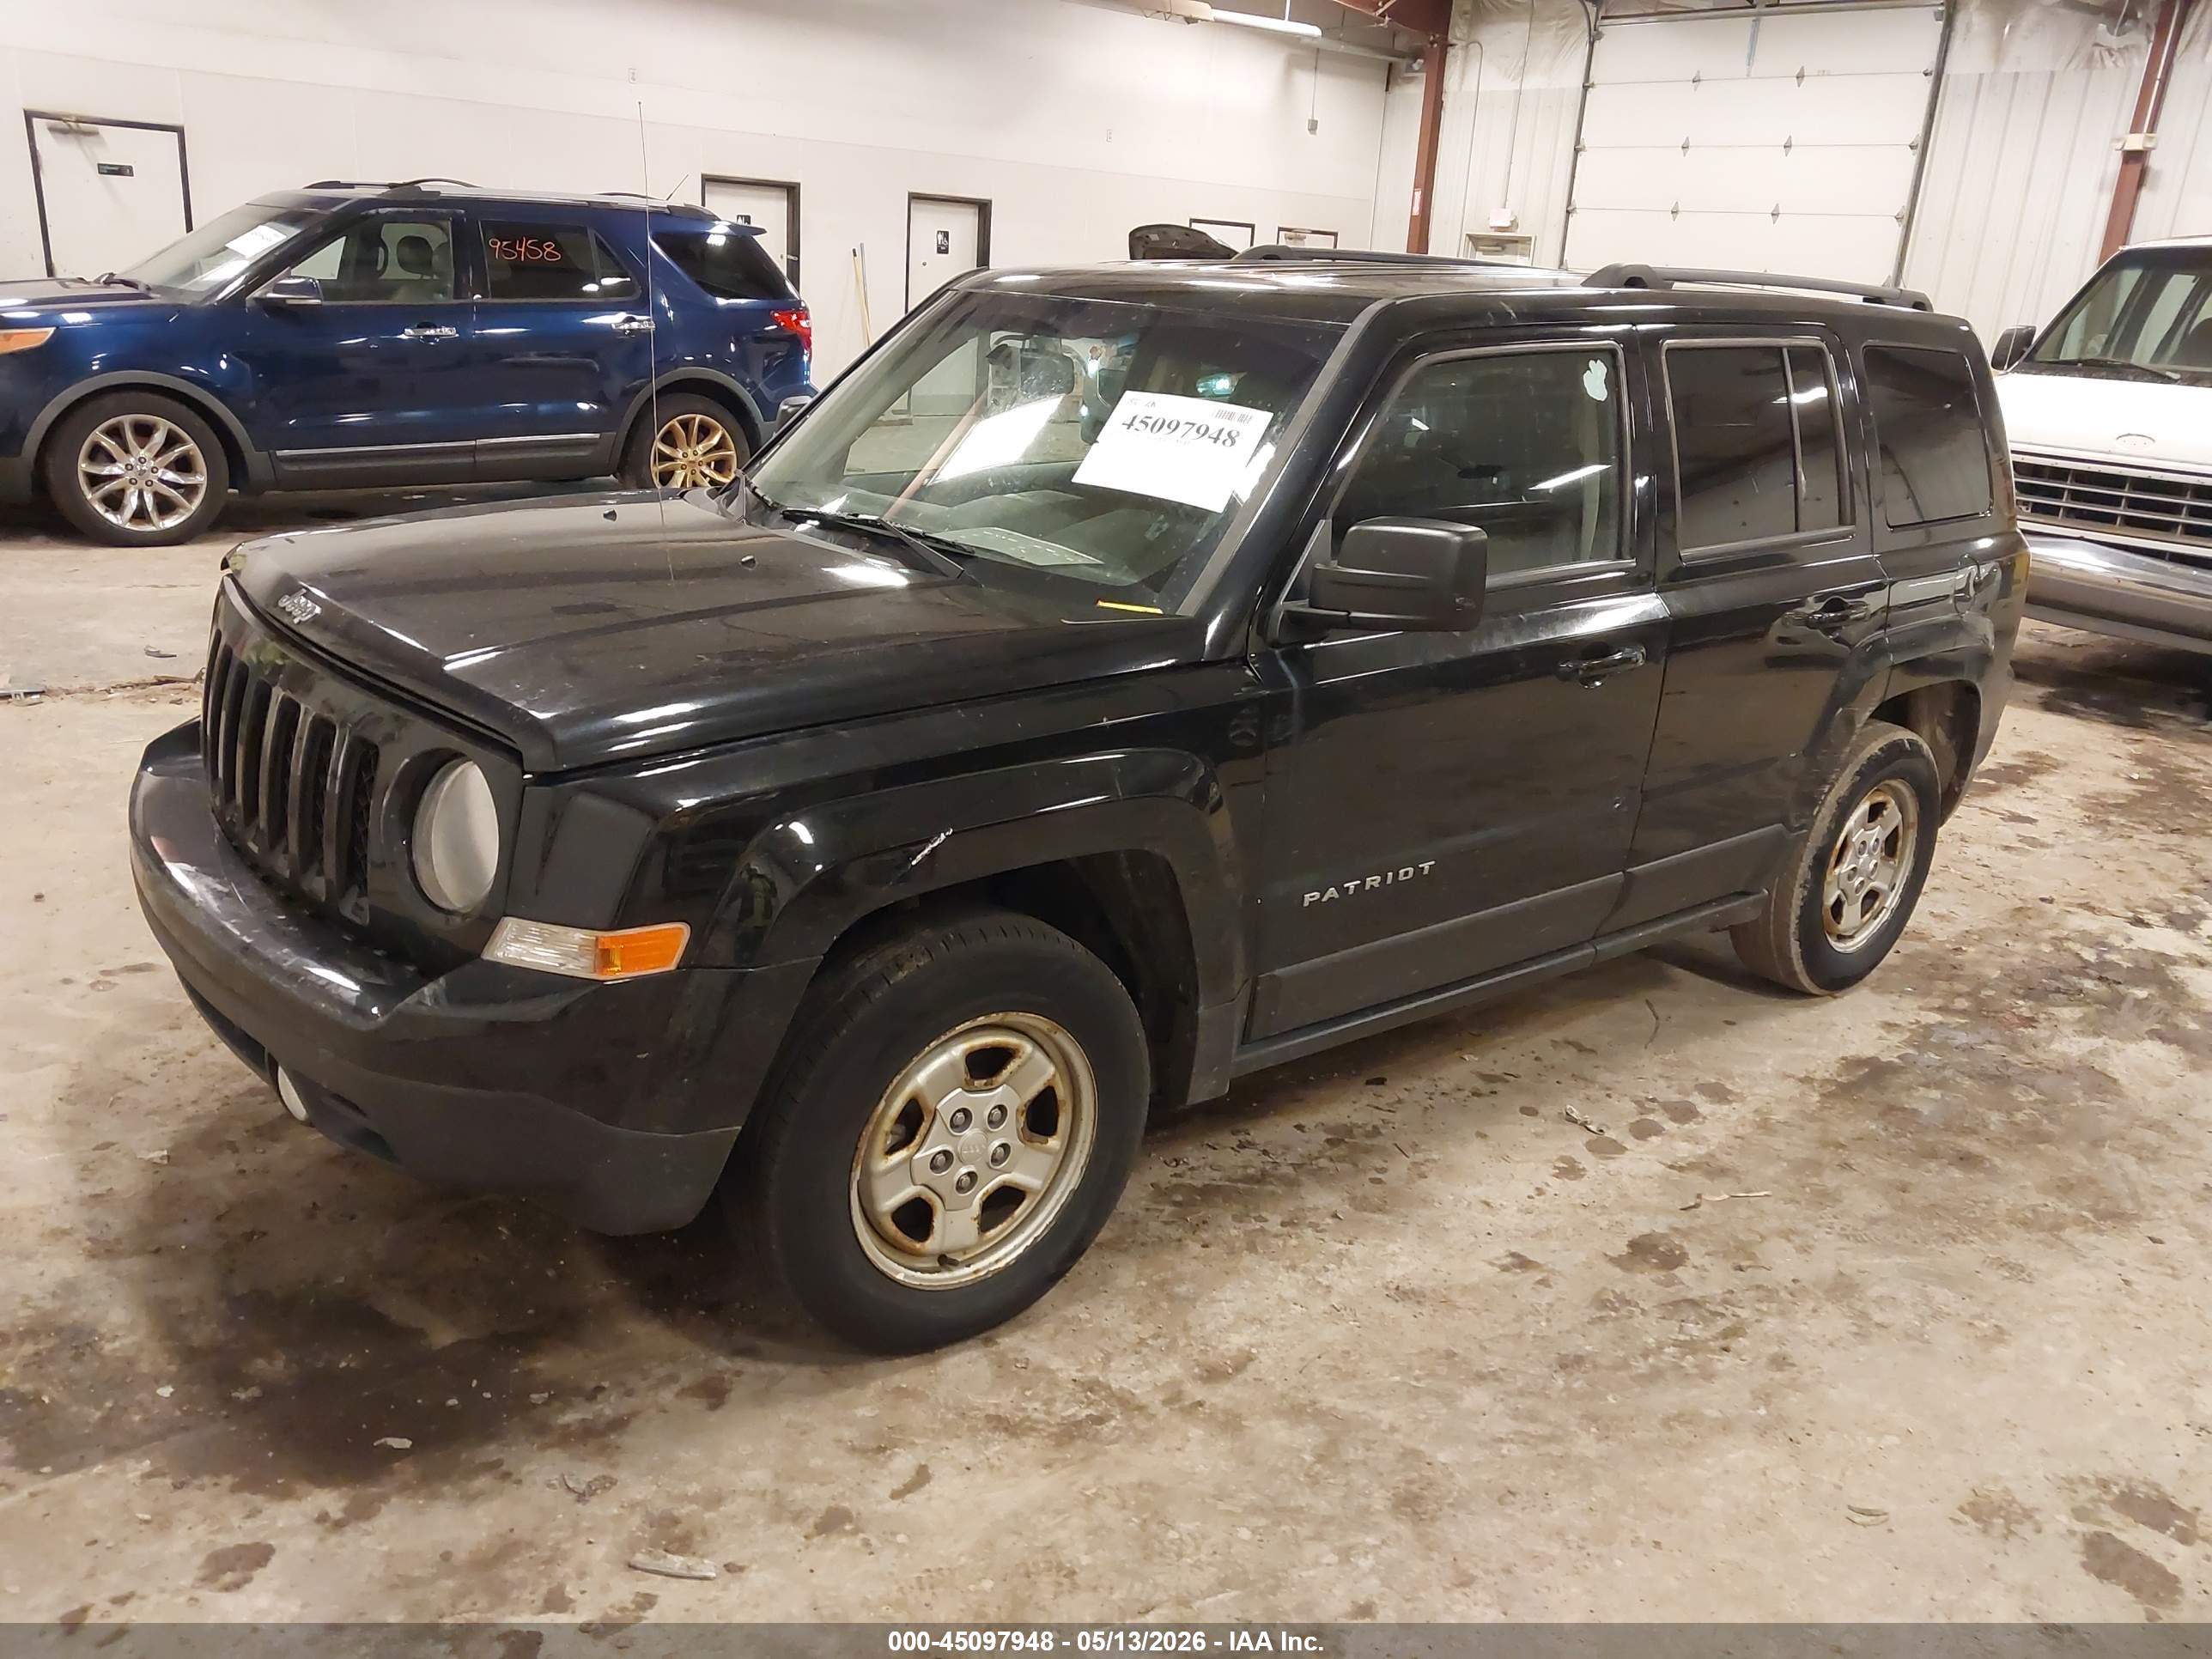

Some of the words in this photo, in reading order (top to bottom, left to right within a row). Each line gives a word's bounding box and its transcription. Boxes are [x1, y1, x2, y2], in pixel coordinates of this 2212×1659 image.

[489, 236, 562, 261] 95458
[1121, 414, 1241, 447] 45097948
[1302, 860, 1436, 908] PATRIOT
